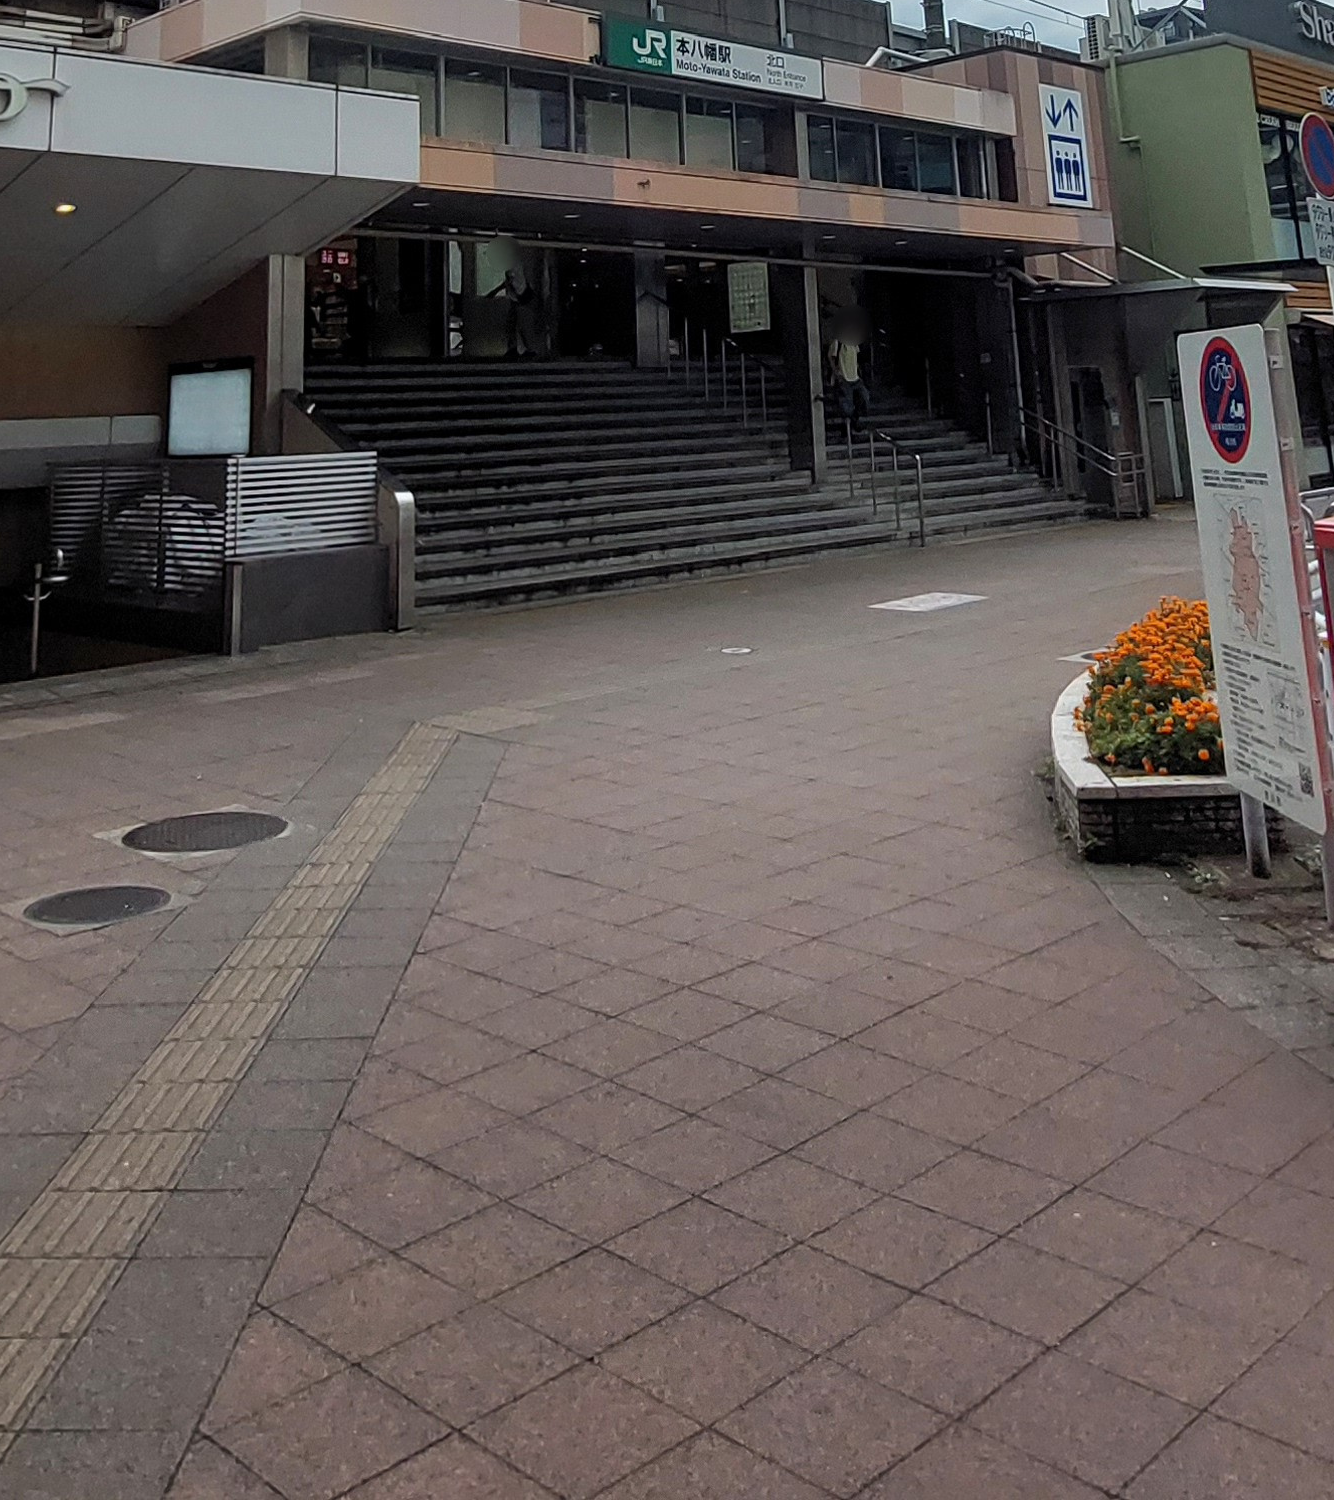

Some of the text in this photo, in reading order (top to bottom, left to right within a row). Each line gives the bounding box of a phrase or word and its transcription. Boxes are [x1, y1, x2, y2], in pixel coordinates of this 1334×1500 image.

[632, 28, 667, 59] JR
[675, 37, 732, 64] 本八幡駅
[675, 58, 762, 84] Moto-Yawata Station
[767, 54, 785, 69] 北口
